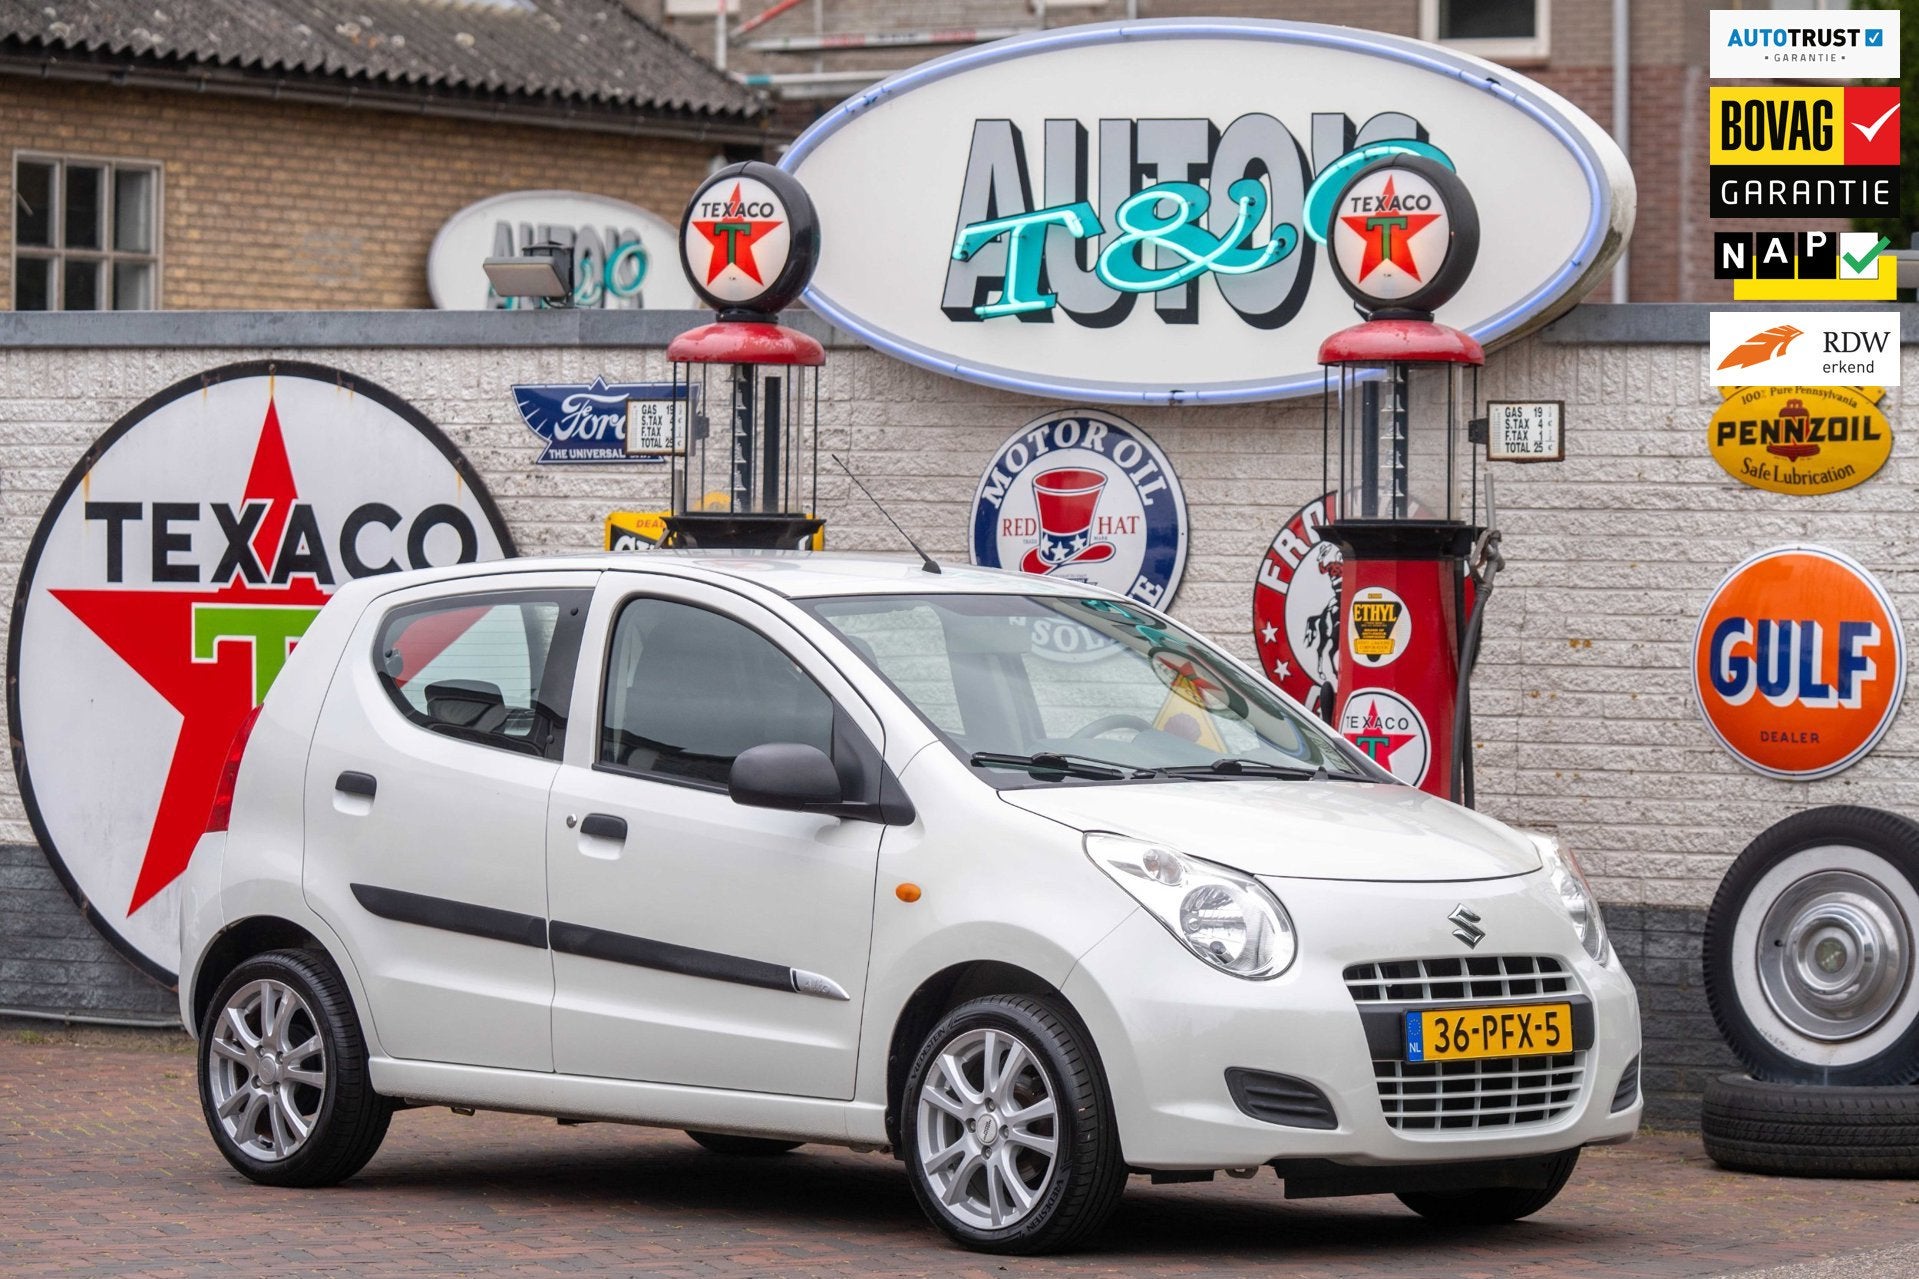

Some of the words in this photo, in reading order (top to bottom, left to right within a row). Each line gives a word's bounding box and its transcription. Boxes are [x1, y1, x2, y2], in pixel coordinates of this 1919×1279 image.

[701, 199, 775, 219] TEXACO
[1350, 193, 1432, 213] TEXACO
[1769, 386, 1793, 396] Pure
[1795, 386, 1858, 408] Pennsylvania
[641, 404, 657, 415] GAS
[1505, 407, 1523, 418] GAS
[1533, 407, 1543, 418] 19
[1505, 418, 1530, 430] S.TAX
[1717, 416, 1882, 447] PENNZOIL
[641, 437, 662, 448] TOTAL
[1505, 430, 1528, 441] F.TAX
[549, 448, 568, 459] THE
[569, 448, 626, 459] UNIVERSAL
[1505, 442, 1531, 453] TOTAL
[1533, 442, 1544, 453] 25
[982, 419, 1109, 509] MOTOR
[1113, 439, 1168, 506] OIL
[1740, 456, 1771, 481] Safe
[1773, 463, 1856, 485] Lubrication
[636, 519, 665, 529] DEAL
[1002, 517, 1037, 537] RED
[1097, 515, 1140, 535] HAT
[84, 501, 479, 585] TEXACO
[1354, 603, 1397, 622] ETHYL
[1709, 616, 1881, 709] GULF
[1346, 715, 1409, 731] TEXACO
[1759, 731, 1820, 744] DEALER
[1433, 1011, 1561, 1053] 36-PFX-5
[1408, 1042, 1422, 1054] NL
